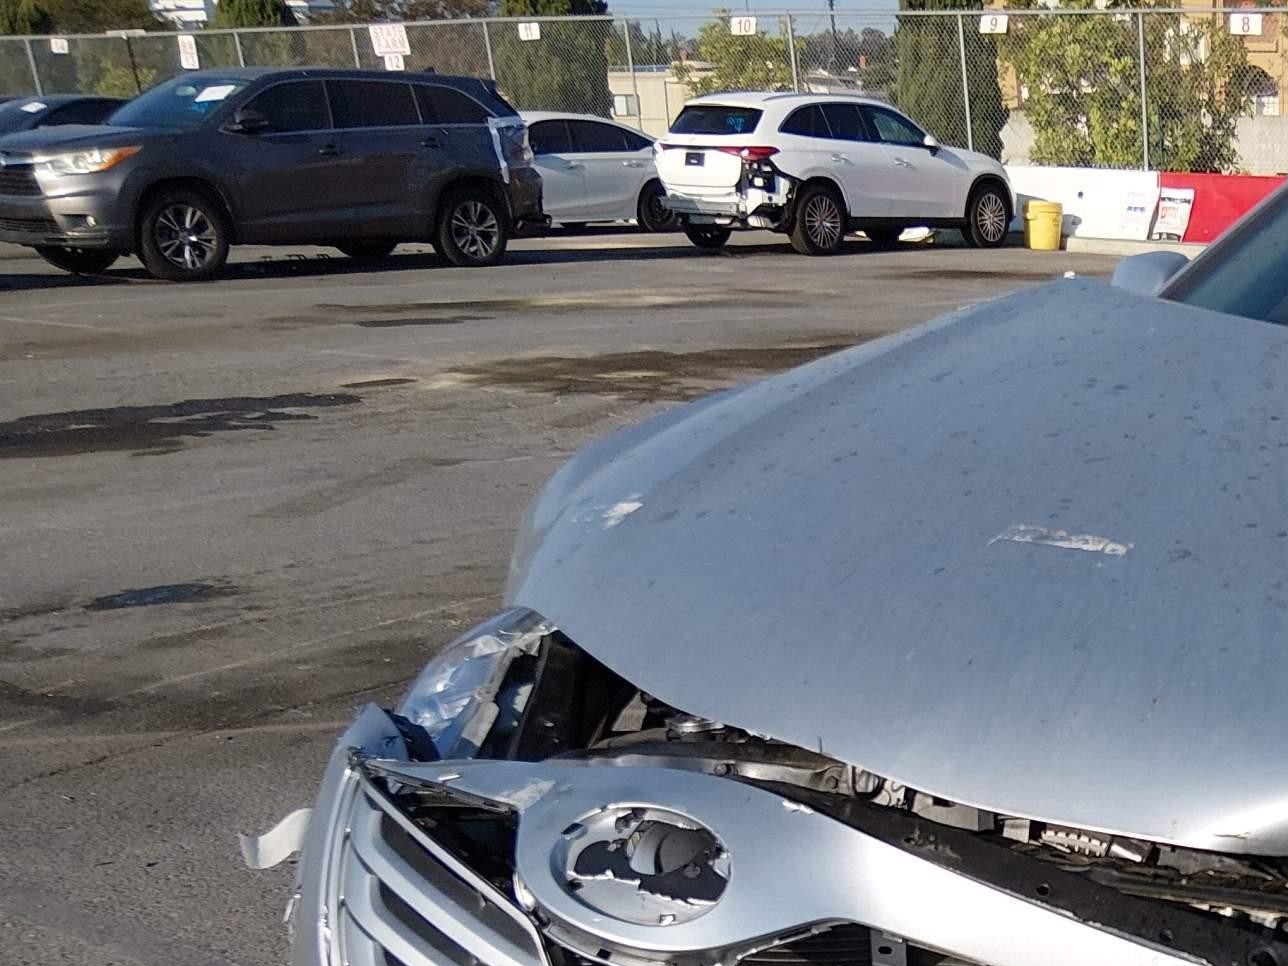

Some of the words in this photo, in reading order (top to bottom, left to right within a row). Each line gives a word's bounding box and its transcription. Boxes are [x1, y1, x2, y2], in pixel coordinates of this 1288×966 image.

[373, 23, 404, 38] STATE
[738, 19, 751, 33] 10
[989, 18, 998, 31] 9
[1241, 18, 1251, 33] 8
[387, 55, 401, 69] 12
